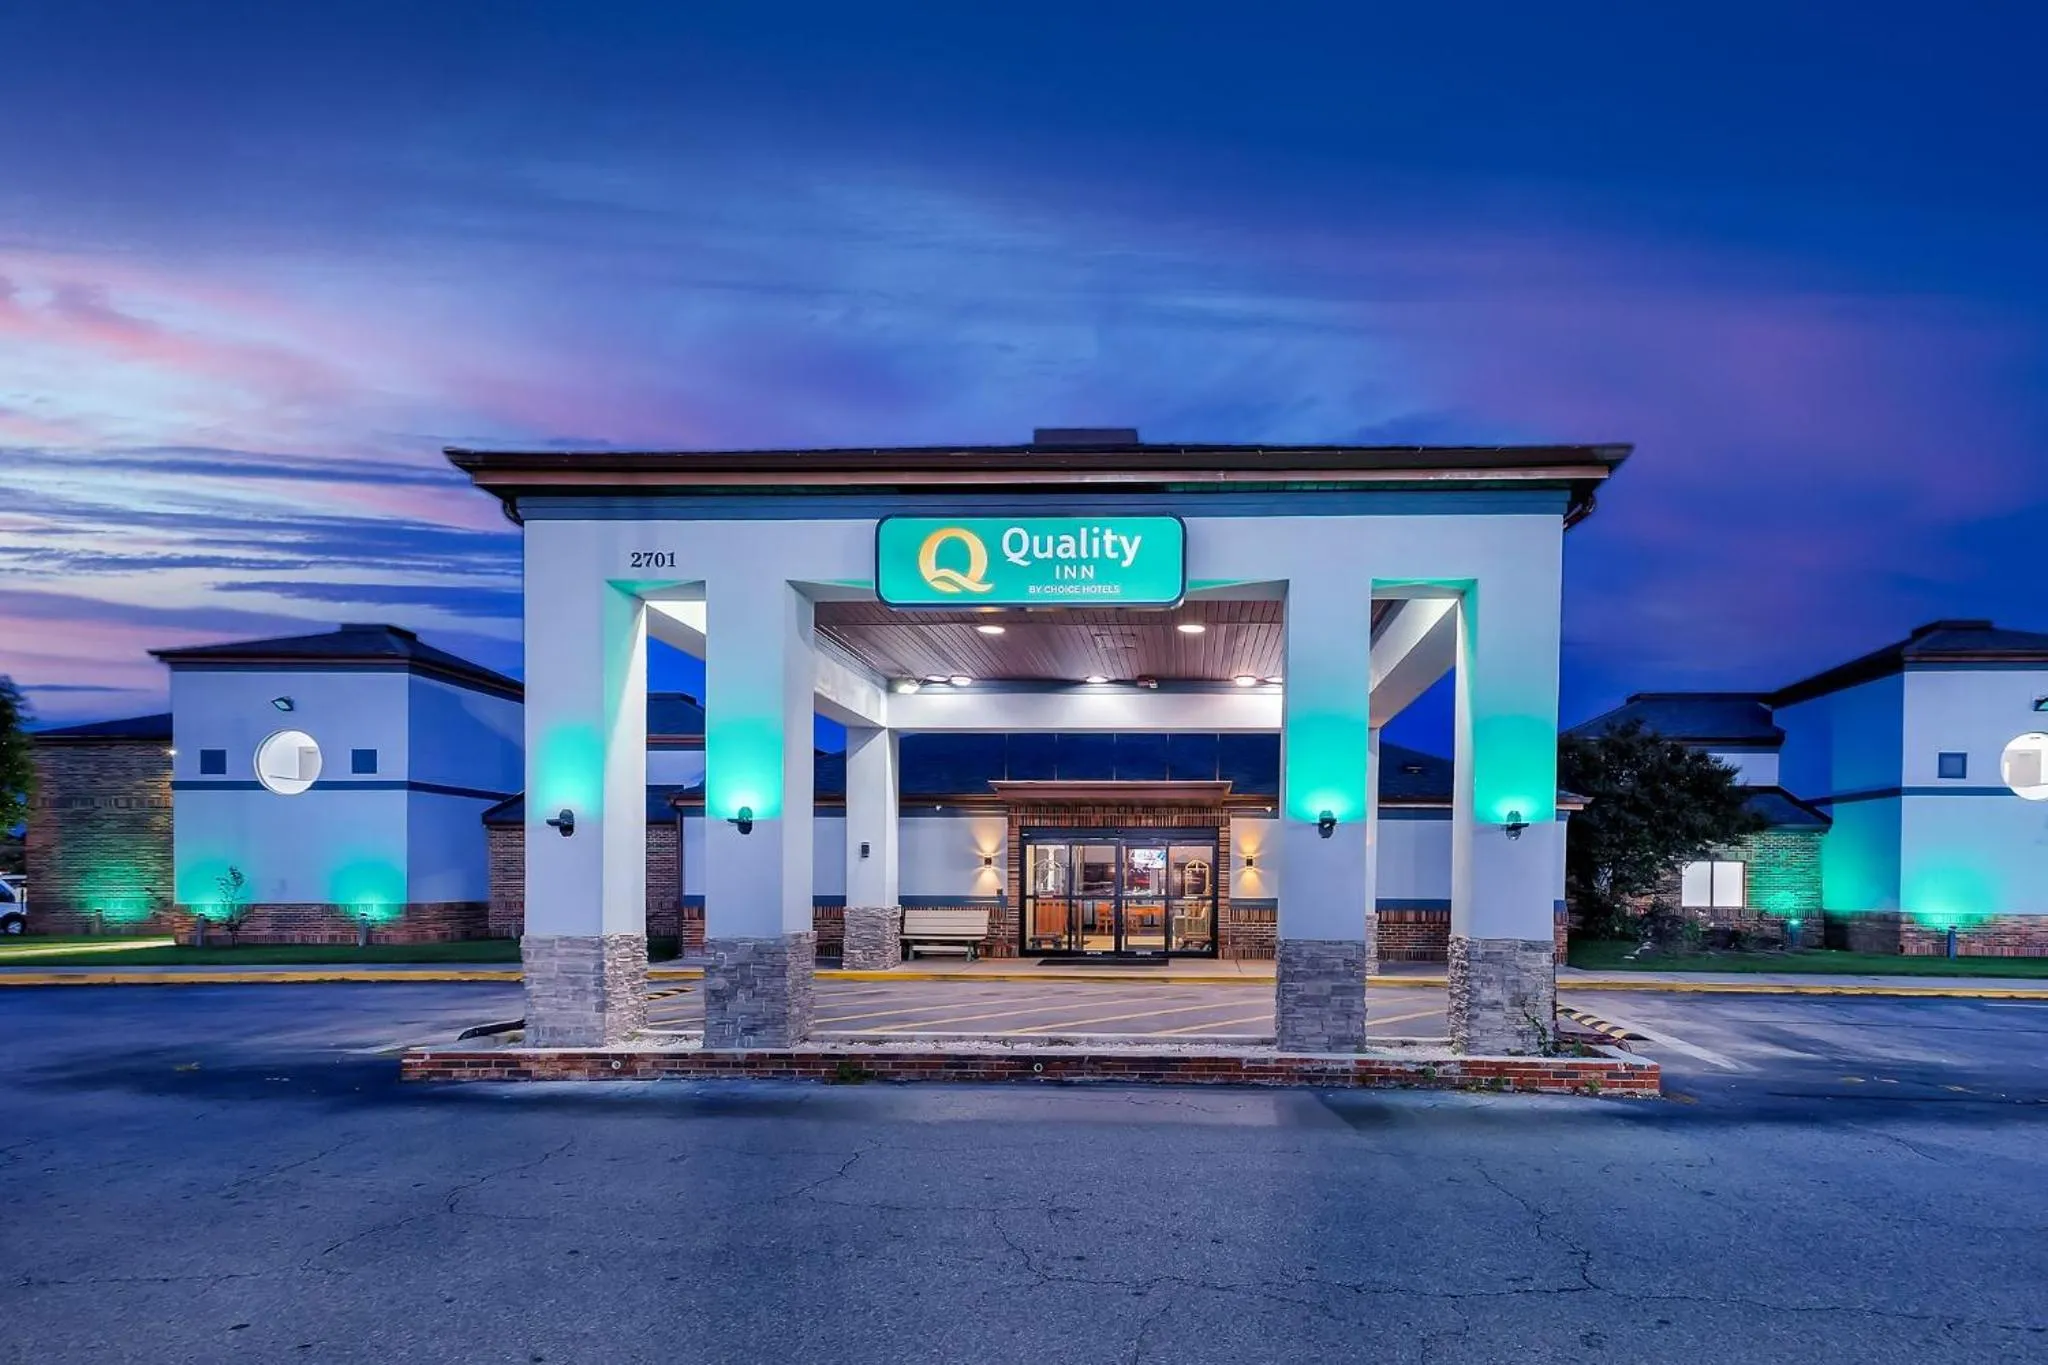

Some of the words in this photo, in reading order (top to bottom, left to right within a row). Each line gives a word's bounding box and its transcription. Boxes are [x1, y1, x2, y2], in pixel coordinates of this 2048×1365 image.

[1002, 526, 1141, 567] Quality
[631, 552, 676, 568] 2701
[1055, 565, 1095, 579] INN
[1029, 585, 1042, 594] BY
[1044, 585, 1080, 594] CHOICE
[1082, 585, 1120, 594] HOTELS
